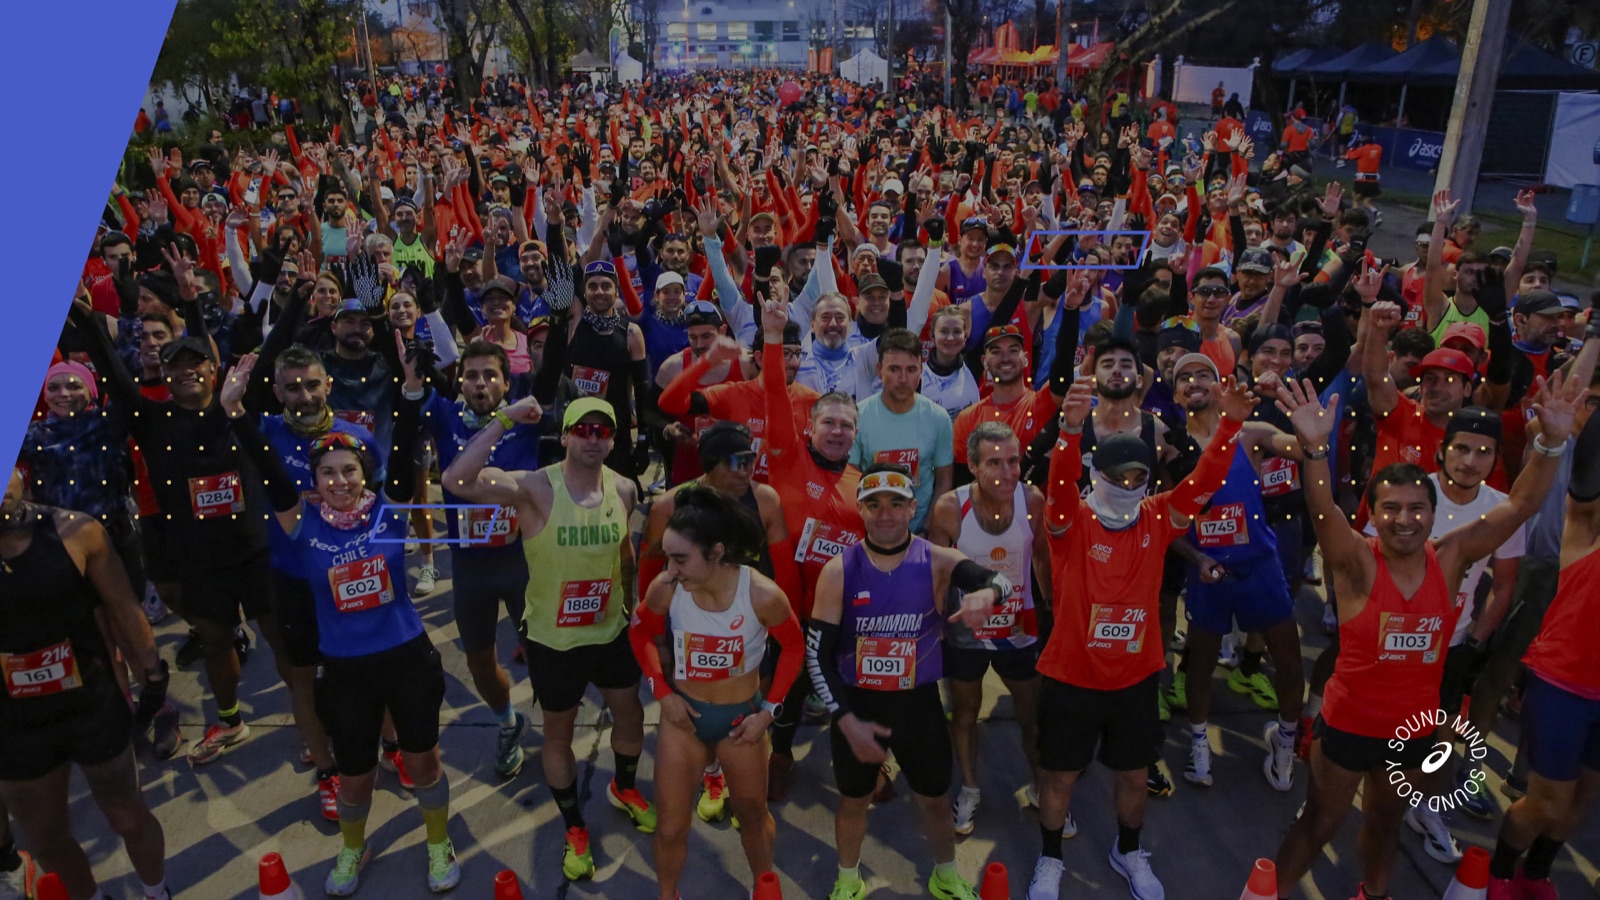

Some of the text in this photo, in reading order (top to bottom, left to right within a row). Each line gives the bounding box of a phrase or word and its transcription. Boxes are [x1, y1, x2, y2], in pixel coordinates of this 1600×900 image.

[1578, 47, 1589, 61] F
[898, 450, 918, 462] 21k
[218, 474, 238, 489] 21k
[1269, 470, 1287, 483] 661
[199, 490, 232, 504] 1284
[1221, 505, 1243, 519] 21k
[557, 522, 620, 546] CRONOS
[1203, 521, 1235, 534] 1745
[837, 530, 858, 545] 21k
[817, 540, 844, 555] 1401
[332, 545, 368, 566] CHILE
[362, 557, 385, 577] 21k
[346, 579, 377, 596] 602
[588, 581, 610, 596] 21k
[567, 598, 599, 611] 1886
[1001, 601, 1023, 613] 21k
[1121, 608, 1147, 622] 21k
[856, 613, 924, 633] TEAMMORA
[1415, 615, 1442, 632] 21k
[1101, 625, 1130, 637] 609
[716, 637, 743, 653] 21k
[888, 641, 914, 656] 21k
[1392, 636, 1427, 648] 1103
[41, 645, 71, 667] 21k
[697, 654, 729, 667] 862
[867, 659, 900, 673] 1091
[24, 668, 53, 682] 161
